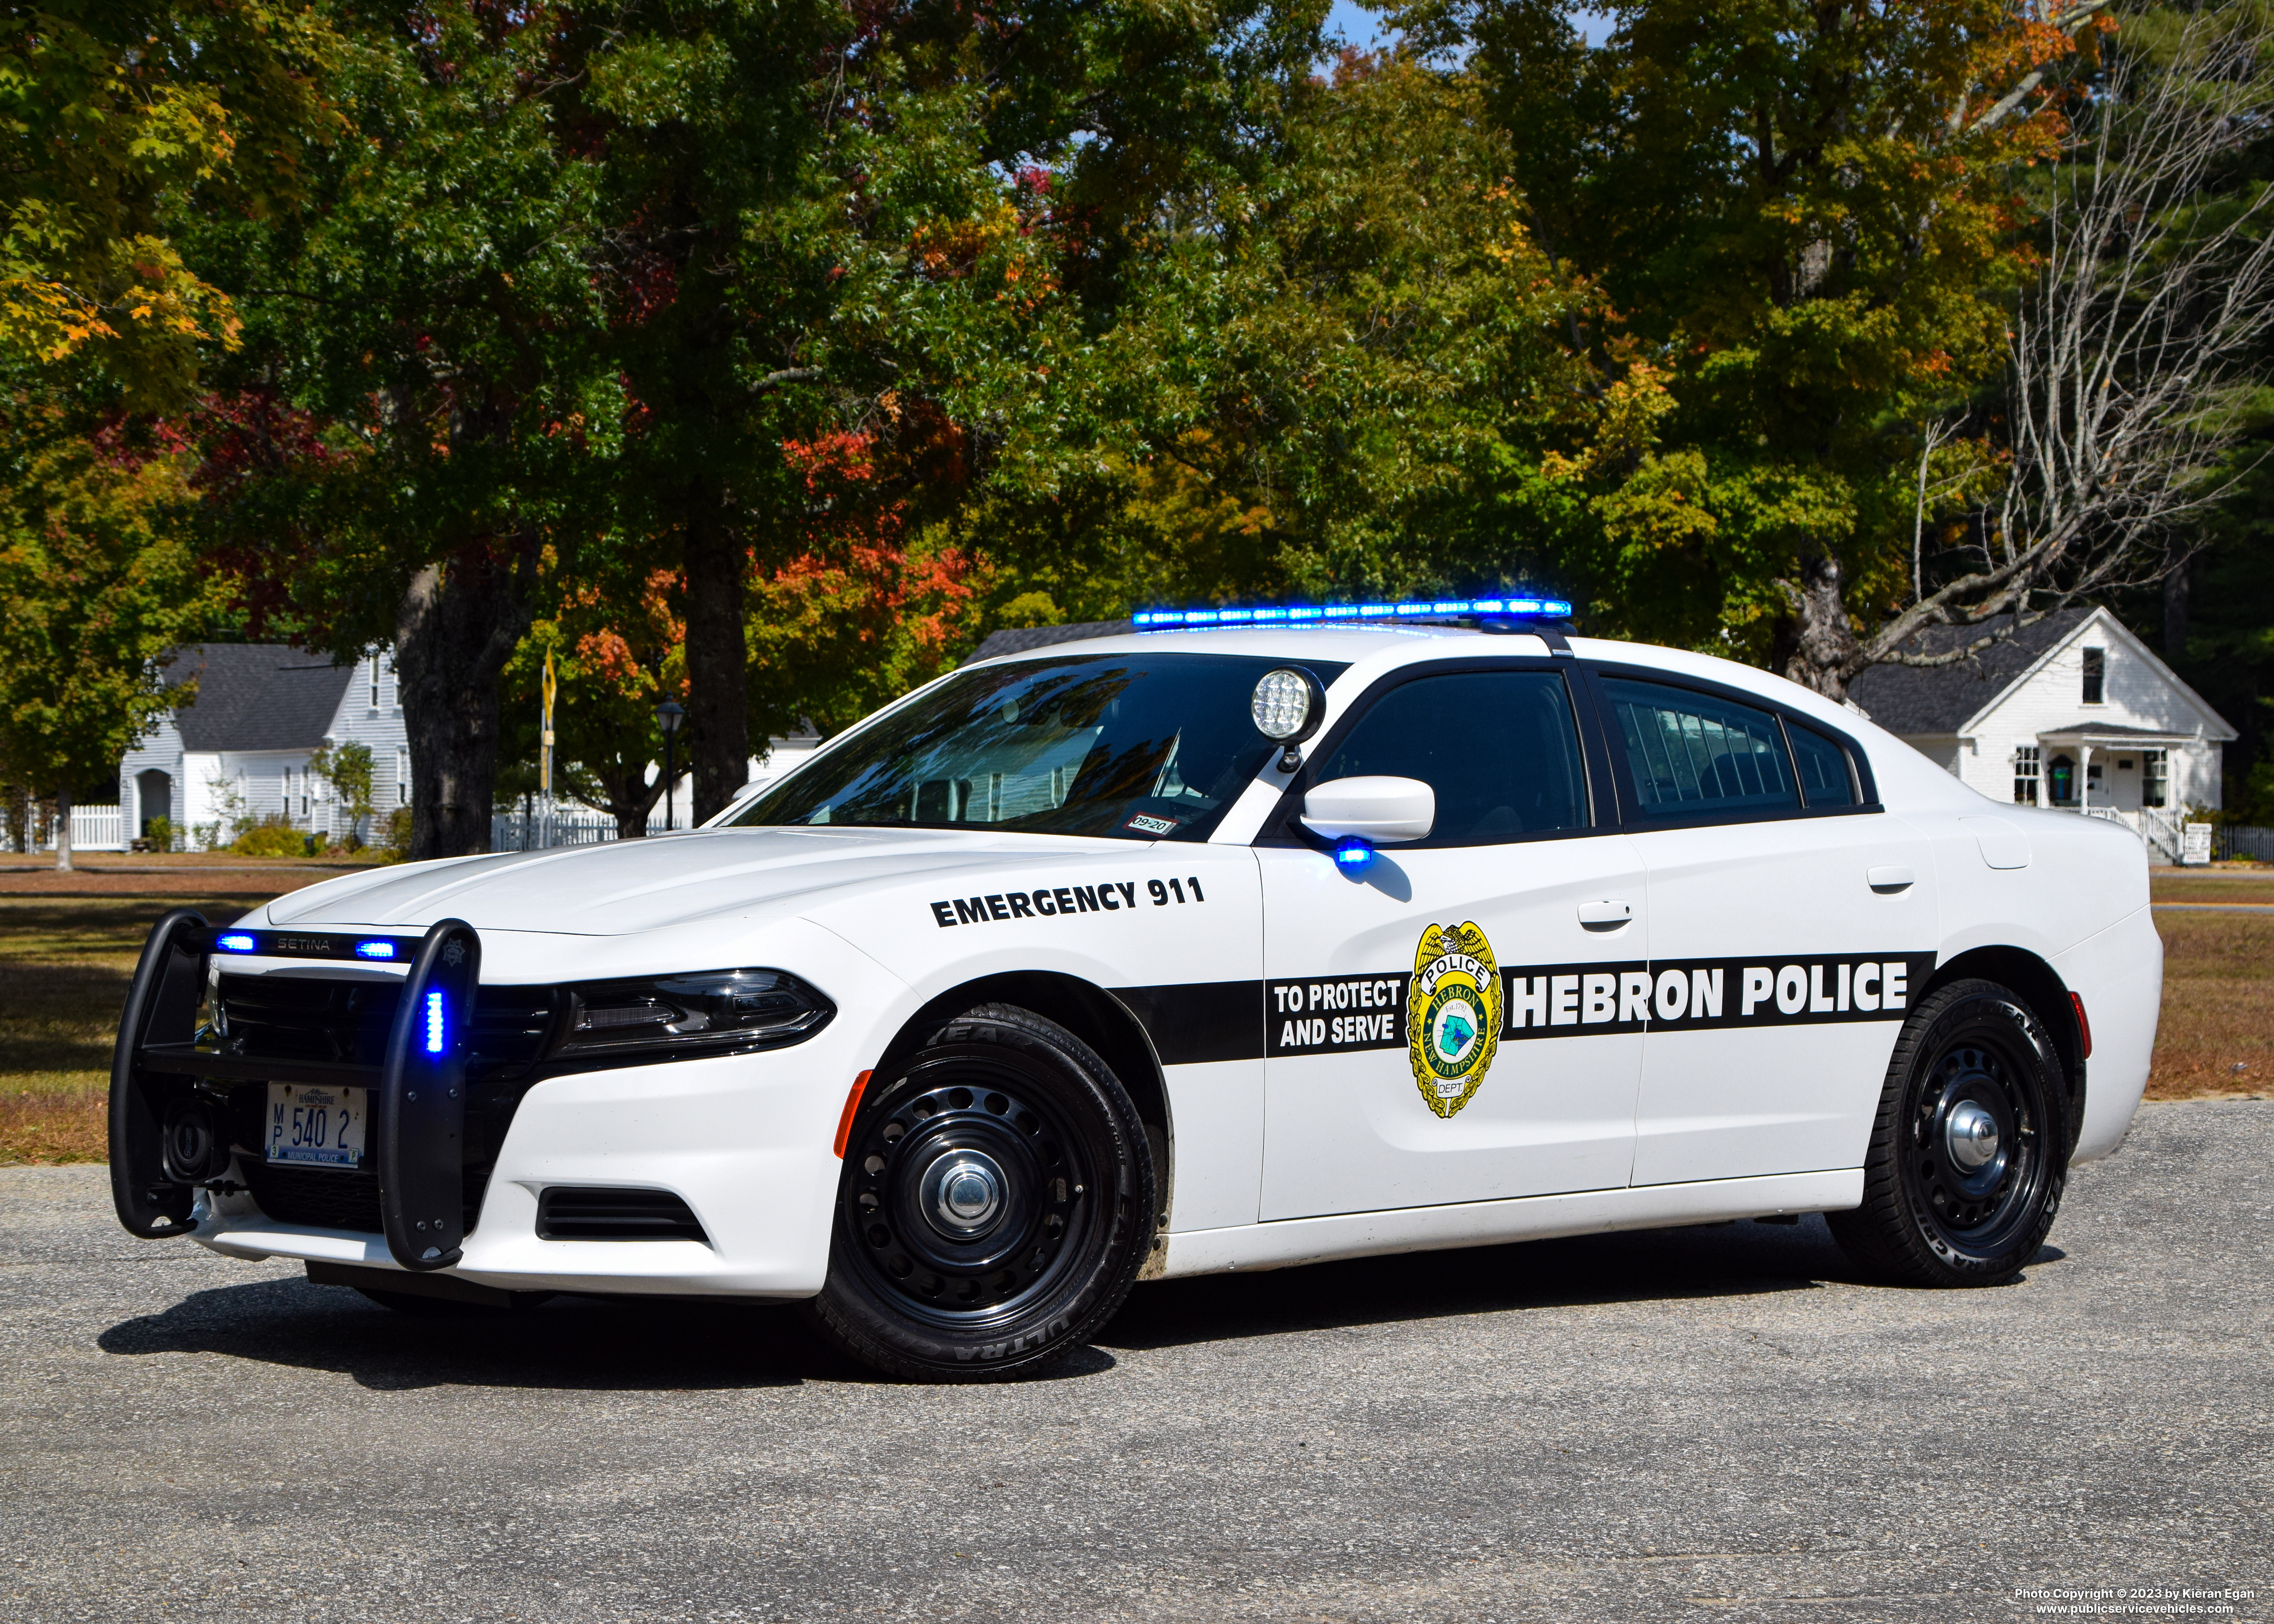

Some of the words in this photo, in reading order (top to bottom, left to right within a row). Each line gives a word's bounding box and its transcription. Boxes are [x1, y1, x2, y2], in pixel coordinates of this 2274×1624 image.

[1132, 817, 1166, 830] 09-20
[930, 881, 1136, 927] EMERGENCY
[1147, 877, 1204, 906] 911
[278, 938, 330, 950] SETINA
[1426, 956, 1485, 984] POLICE
[1274, 985, 1303, 1013] TO
[1309, 980, 1401, 1010] PROTECT
[1432, 986, 1479, 1011] HEBRON
[1456, 1003, 1467, 1012] 1792
[1512, 967, 1724, 1028] HEBRON
[1741, 962, 1907, 1016] POLICE
[1280, 1018, 1326, 1047] AND
[1331, 1014, 1394, 1043] SERVE
[1424, 1031, 1437, 1063] NEW
[1435, 1028, 1485, 1075] HAMPSHIRE
[299, 1094, 335, 1105] HAMPSHIRE
[1439, 1083, 1463, 1093] DEPT.
[293, 1108, 326, 1147] 540
[338, 1109, 349, 1149] 2
[272, 1146, 276, 1156] 3
[288, 1151, 316, 1161] MUNICIPAL
[318, 1154, 338, 1162] POLICE
[954, 1315, 1070, 1360] ULTRA
